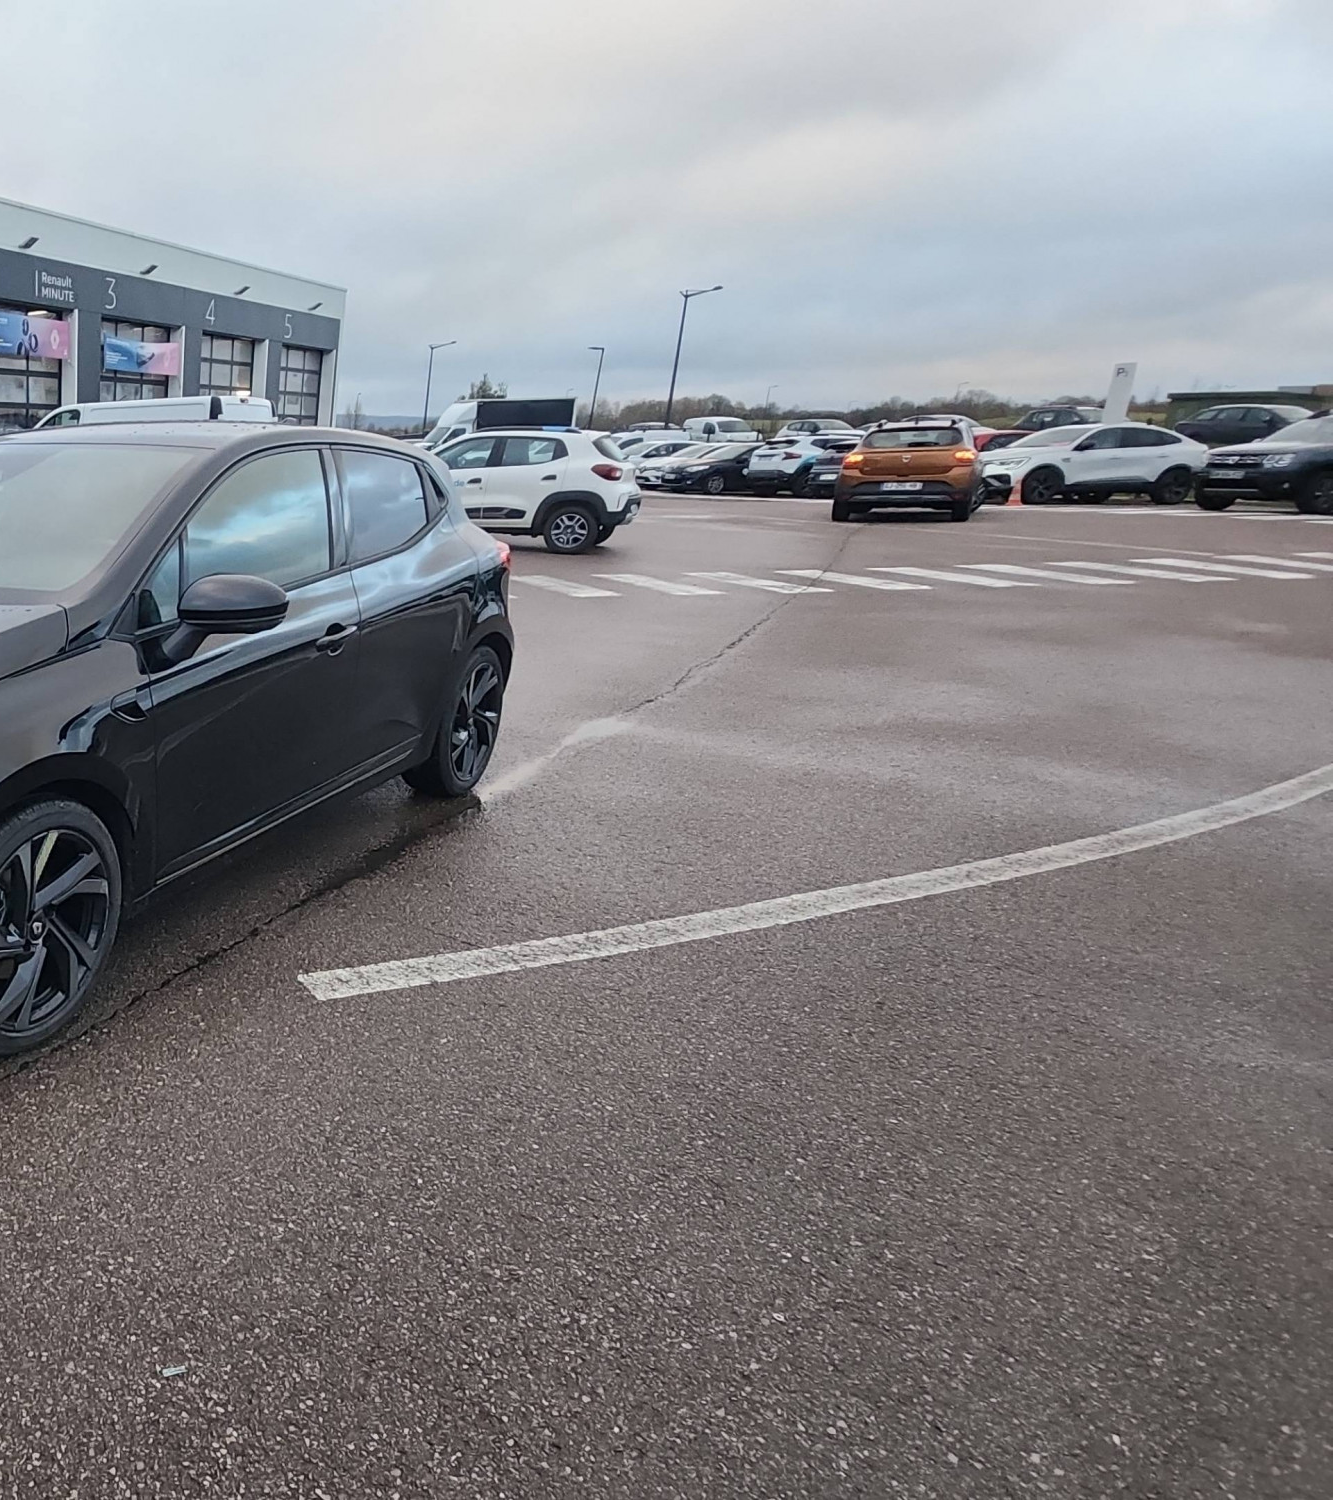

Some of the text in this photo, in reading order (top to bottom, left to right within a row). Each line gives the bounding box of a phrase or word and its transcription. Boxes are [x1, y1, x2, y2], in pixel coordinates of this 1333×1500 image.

[42, 271, 72, 287] Renault
[42, 286, 74, 303] MINUTE
[104, 277, 117, 309] 3
[205, 299, 215, 325] 4
[284, 314, 293, 338] 5
